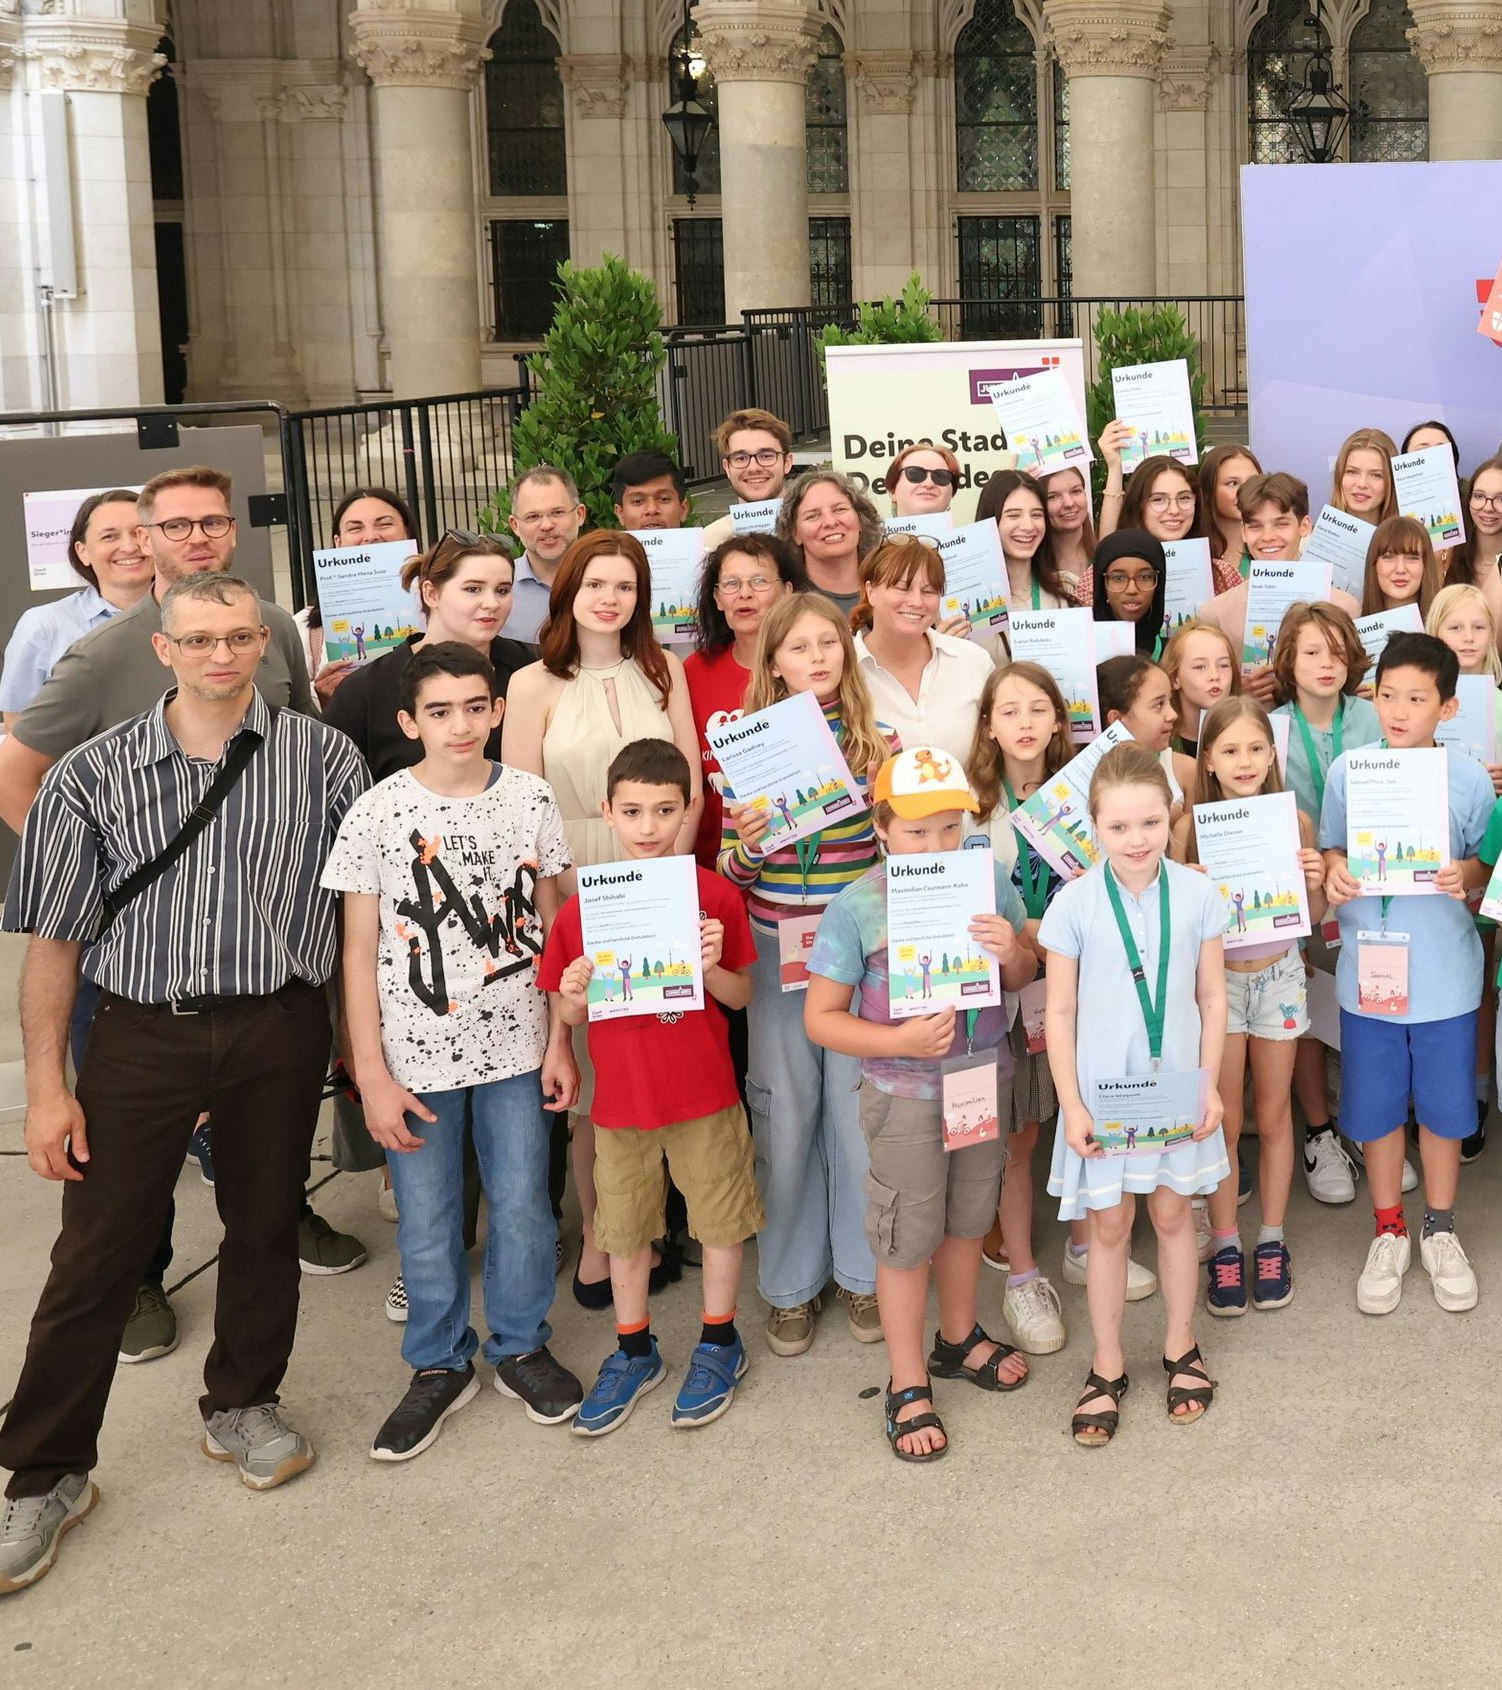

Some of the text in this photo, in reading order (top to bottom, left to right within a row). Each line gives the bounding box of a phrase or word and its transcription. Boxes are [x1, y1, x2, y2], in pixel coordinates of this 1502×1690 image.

[1114, 371, 1153, 383] Urkunde
[993, 383, 1032, 399] Urkunde
[941, 426, 1008, 453] Stad
[1394, 457, 1426, 472] Urkunde
[733, 508, 774, 520] Urkunde
[884, 523, 917, 535] rkunde
[1321, 512, 1359, 534] Urkunde
[940, 535, 967, 550] kunde
[318, 554, 371, 568] Urkunde
[1252, 568, 1294, 578] Urkunde
[1012, 619, 1056, 631] Urkunde
[713, 719, 770, 749] Urkunde
[1349, 759, 1401, 770] Urkunde
[1198, 808, 1250, 824] Urkunde
[443, 835, 478, 851] LET'S
[462, 850, 496, 866] MAKE
[483, 866, 492, 881] IT
[890, 862, 946, 878] Urkunde
[582, 870, 643, 888] Urkunde
[891, 886, 922, 894] Maximilian
[584, 893, 626, 904] Josef Shihabi
[1098, 1080, 1158, 1091] Urkunde
